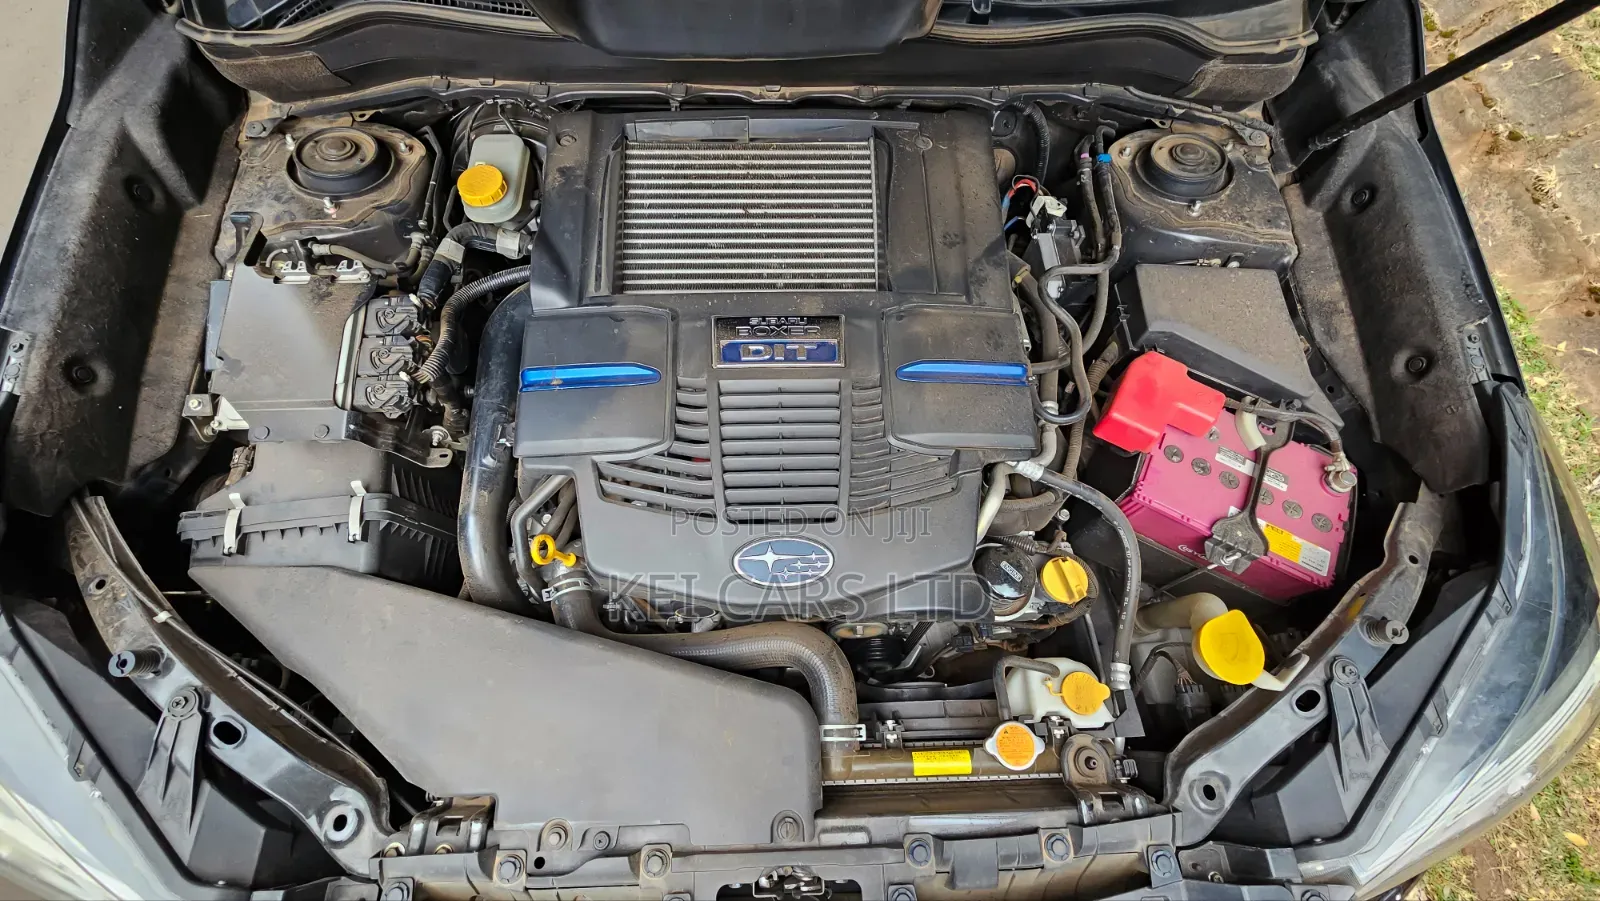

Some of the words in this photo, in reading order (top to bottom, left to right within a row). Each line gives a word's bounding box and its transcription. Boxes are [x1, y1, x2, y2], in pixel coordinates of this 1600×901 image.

[749, 317, 808, 325] SUBARU
[735, 326, 821, 336] BOXER
[740, 344, 818, 361] DIT
